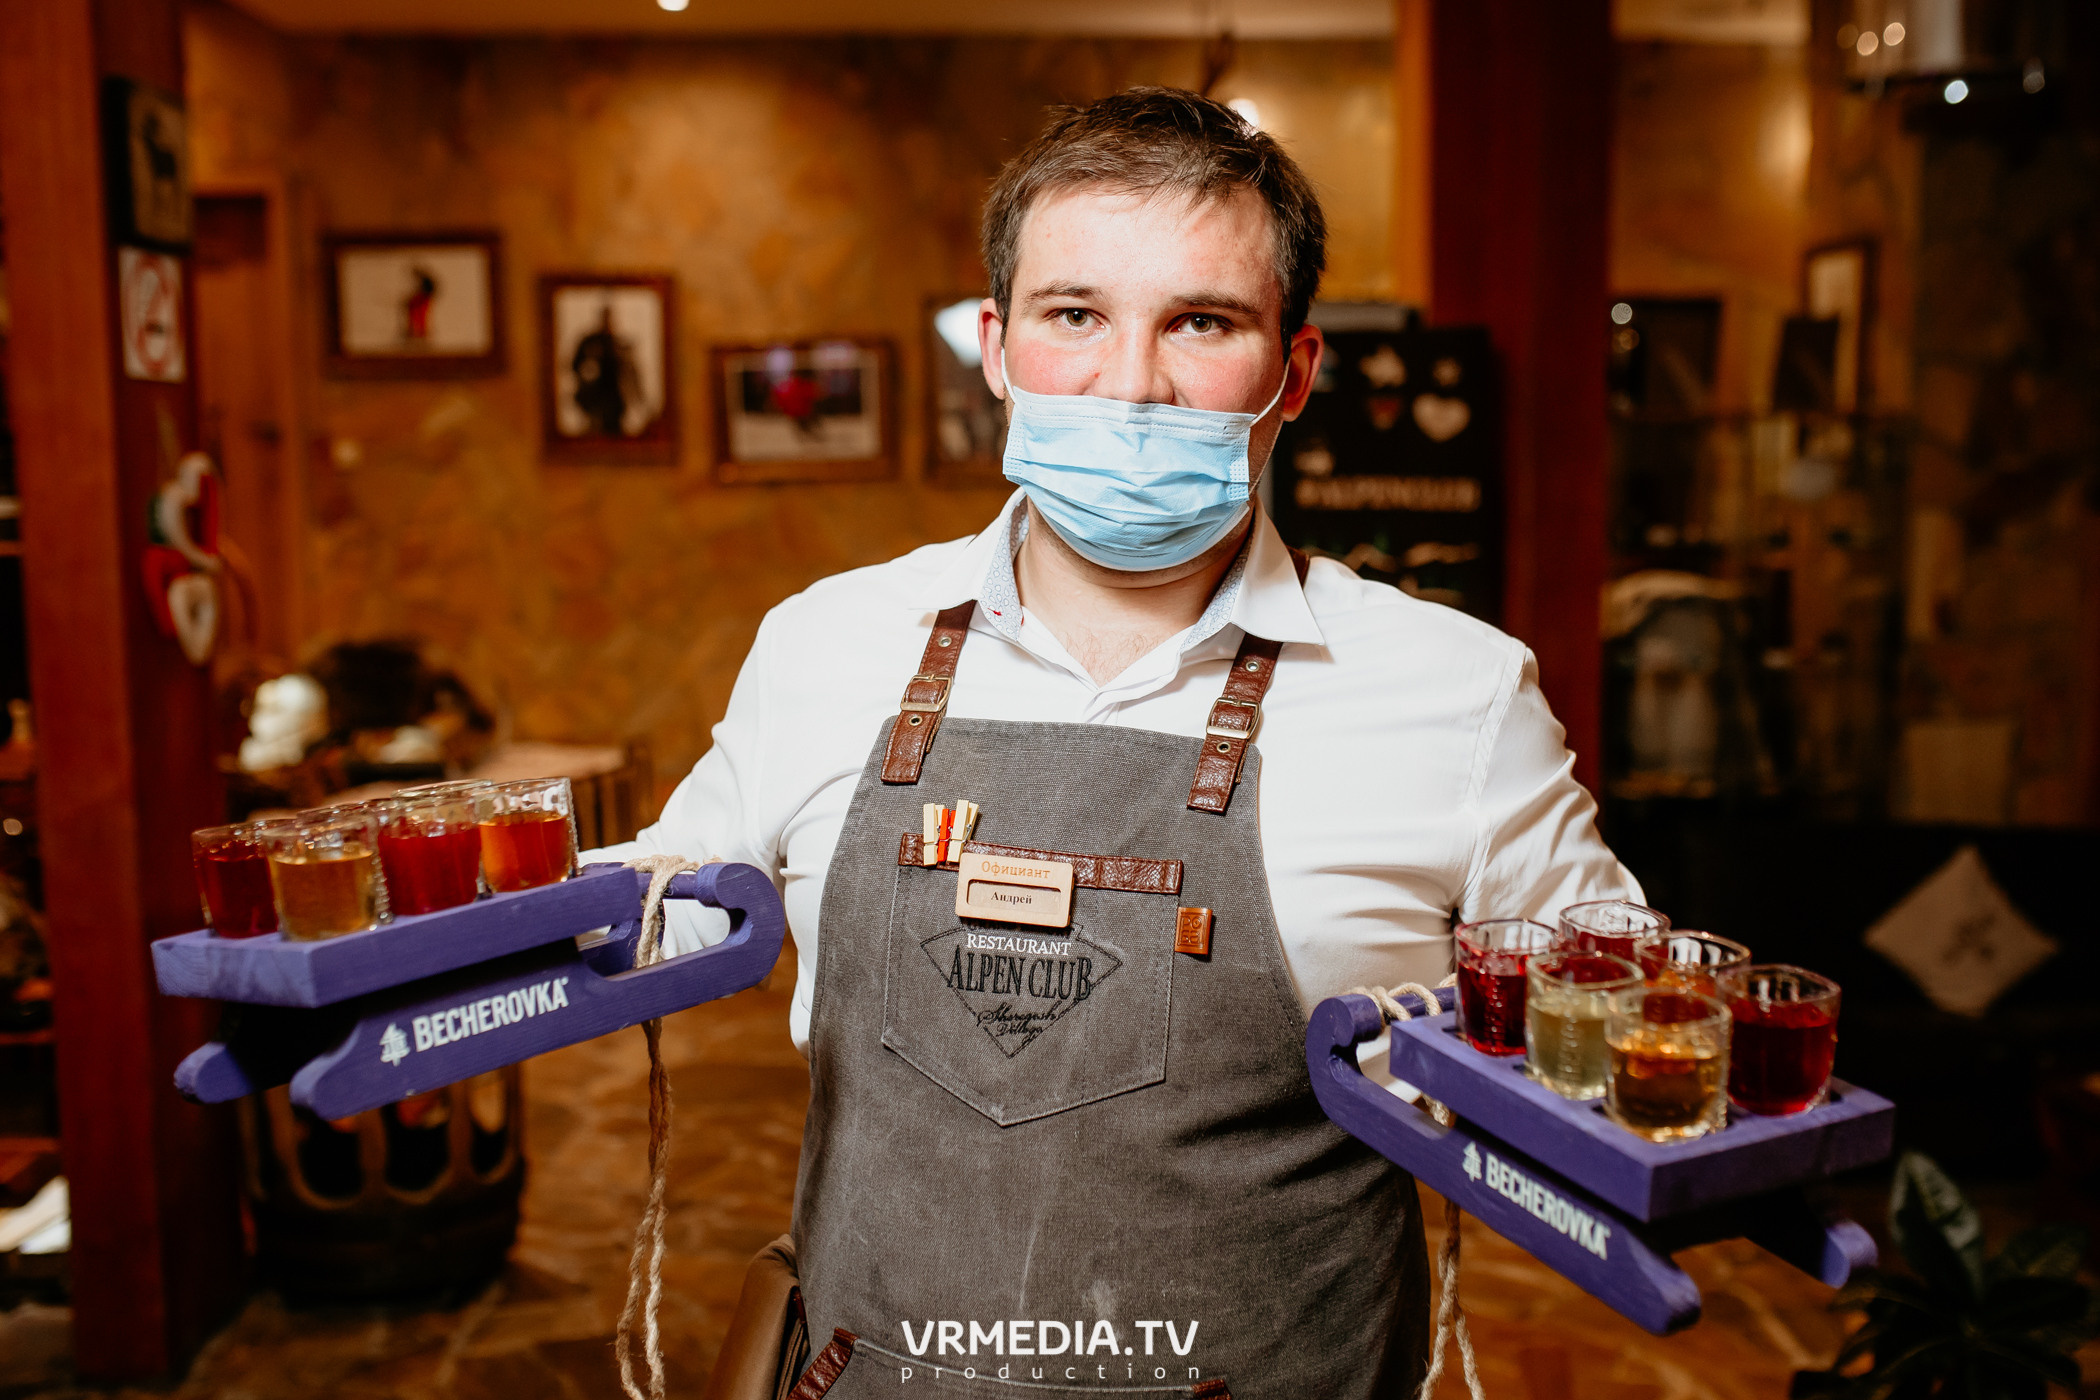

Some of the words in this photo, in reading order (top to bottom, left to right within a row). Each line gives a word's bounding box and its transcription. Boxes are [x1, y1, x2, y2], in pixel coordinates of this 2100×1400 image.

[981, 860, 1051, 879] Официант
[990, 891, 1032, 905] Андрей
[966, 933, 1071, 956] RESTAURANT
[947, 945, 1026, 996] ALPEN
[1028, 957, 1092, 1001] CLUB
[412, 977, 569, 1052] BECHEROVKA
[1486, 1152, 1611, 1261] BECHEROVKA
